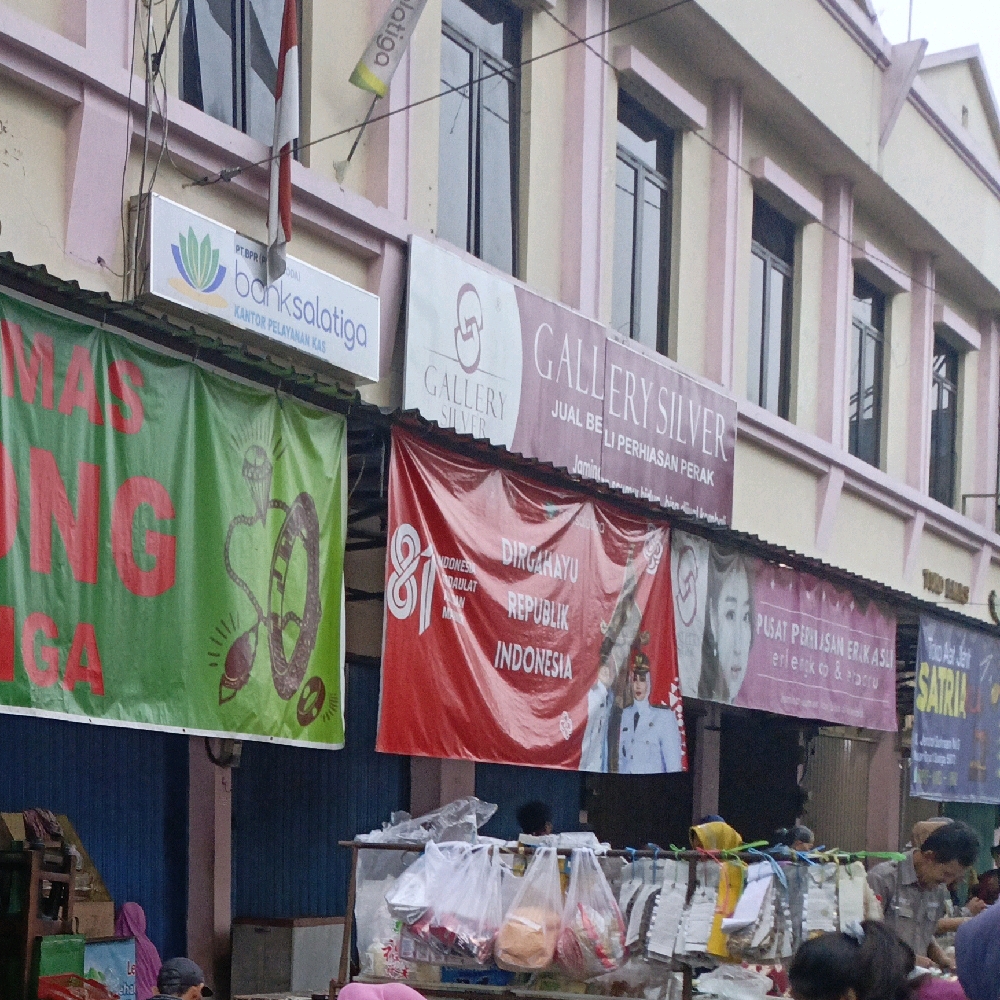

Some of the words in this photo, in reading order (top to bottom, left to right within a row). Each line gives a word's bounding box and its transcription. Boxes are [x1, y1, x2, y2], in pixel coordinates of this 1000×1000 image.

[373, 0, 414, 67] latiga
[234, 304, 266, 328] KANTOR
[267, 318, 311, 347] PELAYANAN
[311, 337, 327, 353] KAS
[424, 364, 506, 421] GALLERY
[534, 322, 655, 430] GALLERY
[656, 386, 728, 462] SILVER
[441, 404, 487, 439] SILVER
[551, 400, 582, 427] JUAL
[586, 414, 615, 449] BELI
[617, 436, 679, 473] PERHIASAN
[681, 461, 715, 487] PERAK
[501, 537, 579, 584] DIRGAHAYU
[507, 590, 569, 631] REPUBLIK
[494, 640, 573, 680] INDONESIA
[756, 613, 788, 643] PUSAT
[872, 648, 894, 669] ASLI
[834, 660, 843, 680] &
[916, 661, 967, 719] SATRIA
